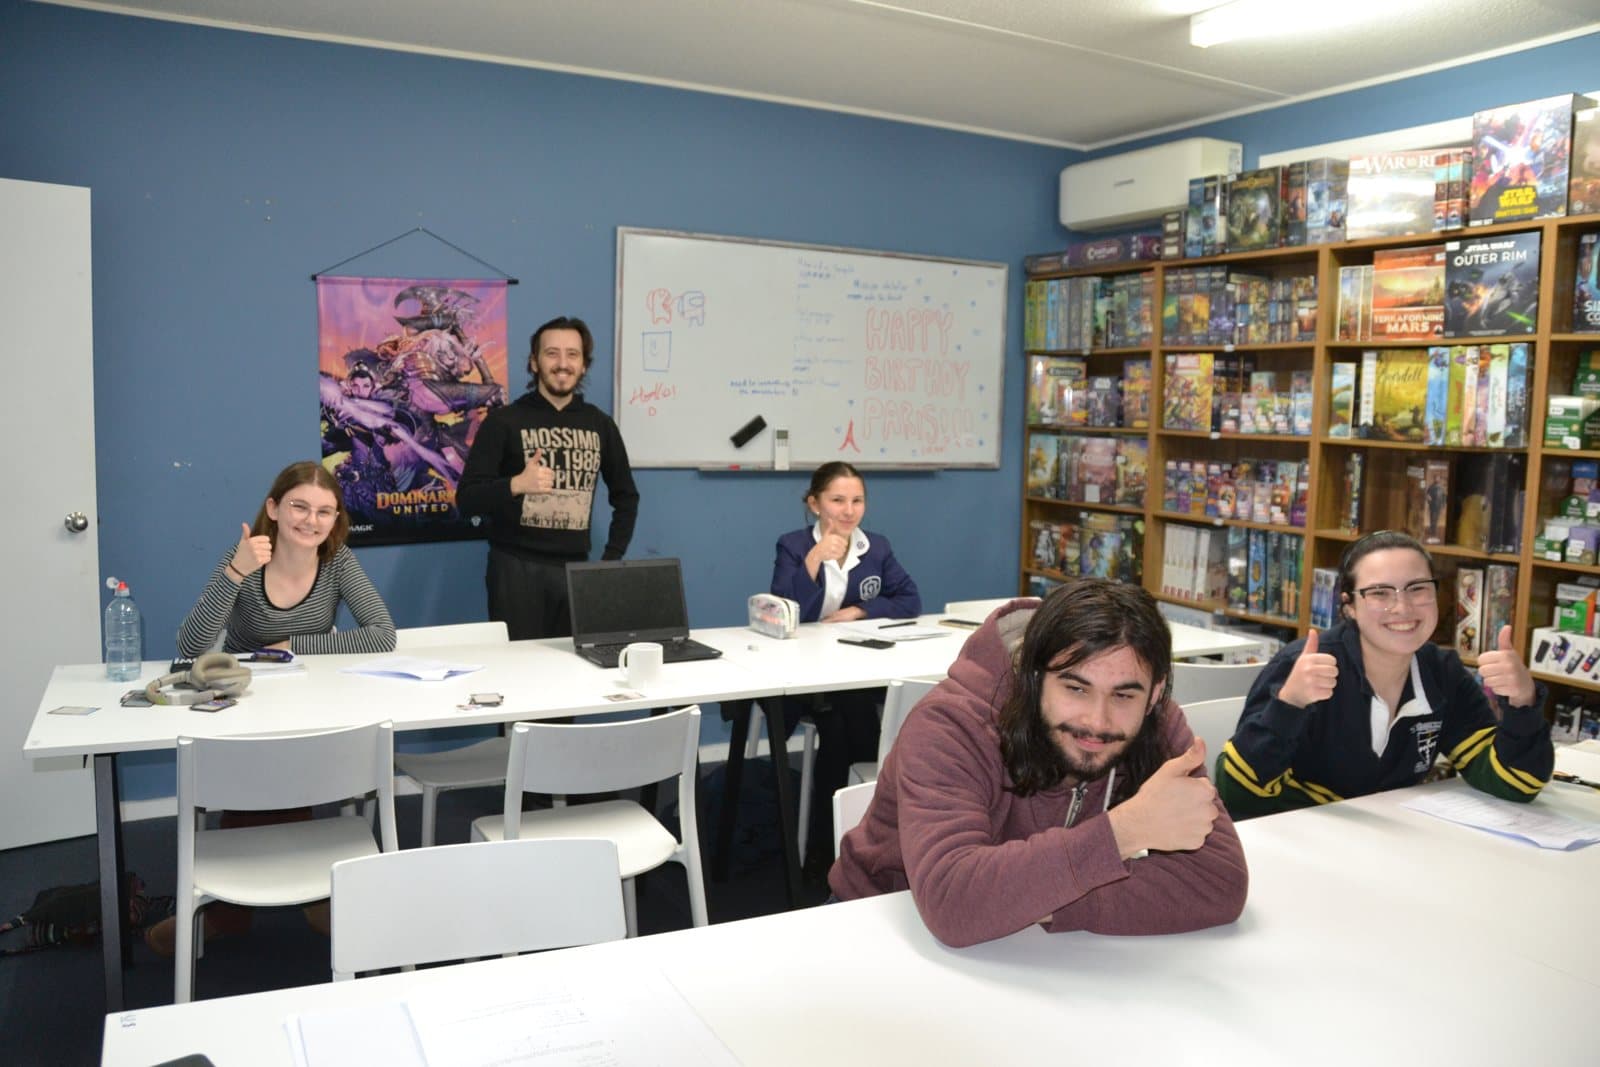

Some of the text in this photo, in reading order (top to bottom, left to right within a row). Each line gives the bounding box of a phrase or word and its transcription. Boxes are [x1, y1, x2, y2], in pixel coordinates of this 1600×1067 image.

[1362, 153, 1406, 174] WAR
[1453, 249, 1528, 267] OUTER RIM
[864, 306, 954, 356] HAPPY
[1386, 321, 1430, 333] MARS
[520, 427, 600, 452] MOSSIMO
[393, 503, 449, 514] UNITED
